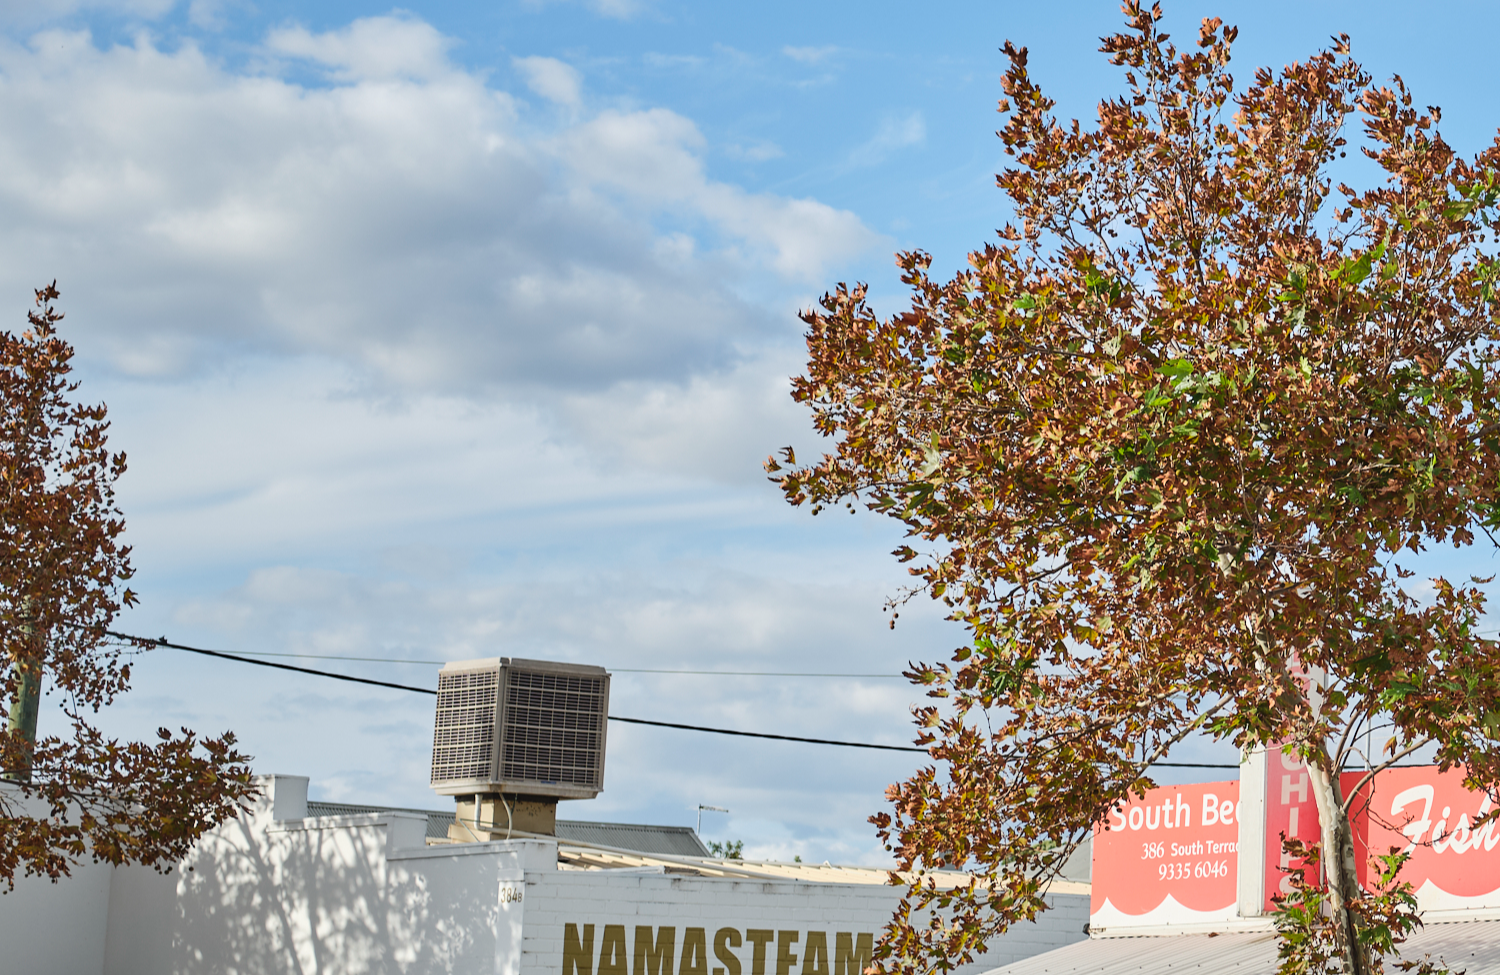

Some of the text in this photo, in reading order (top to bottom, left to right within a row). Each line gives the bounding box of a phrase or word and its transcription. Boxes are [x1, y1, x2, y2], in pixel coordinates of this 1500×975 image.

[1109, 793, 1191, 832] South
[1391, 780, 1500, 854] Fish
[1141, 841, 1165, 860] 386
[1170, 842, 1204, 857] South
[1158, 859, 1228, 881] 9335 6046
